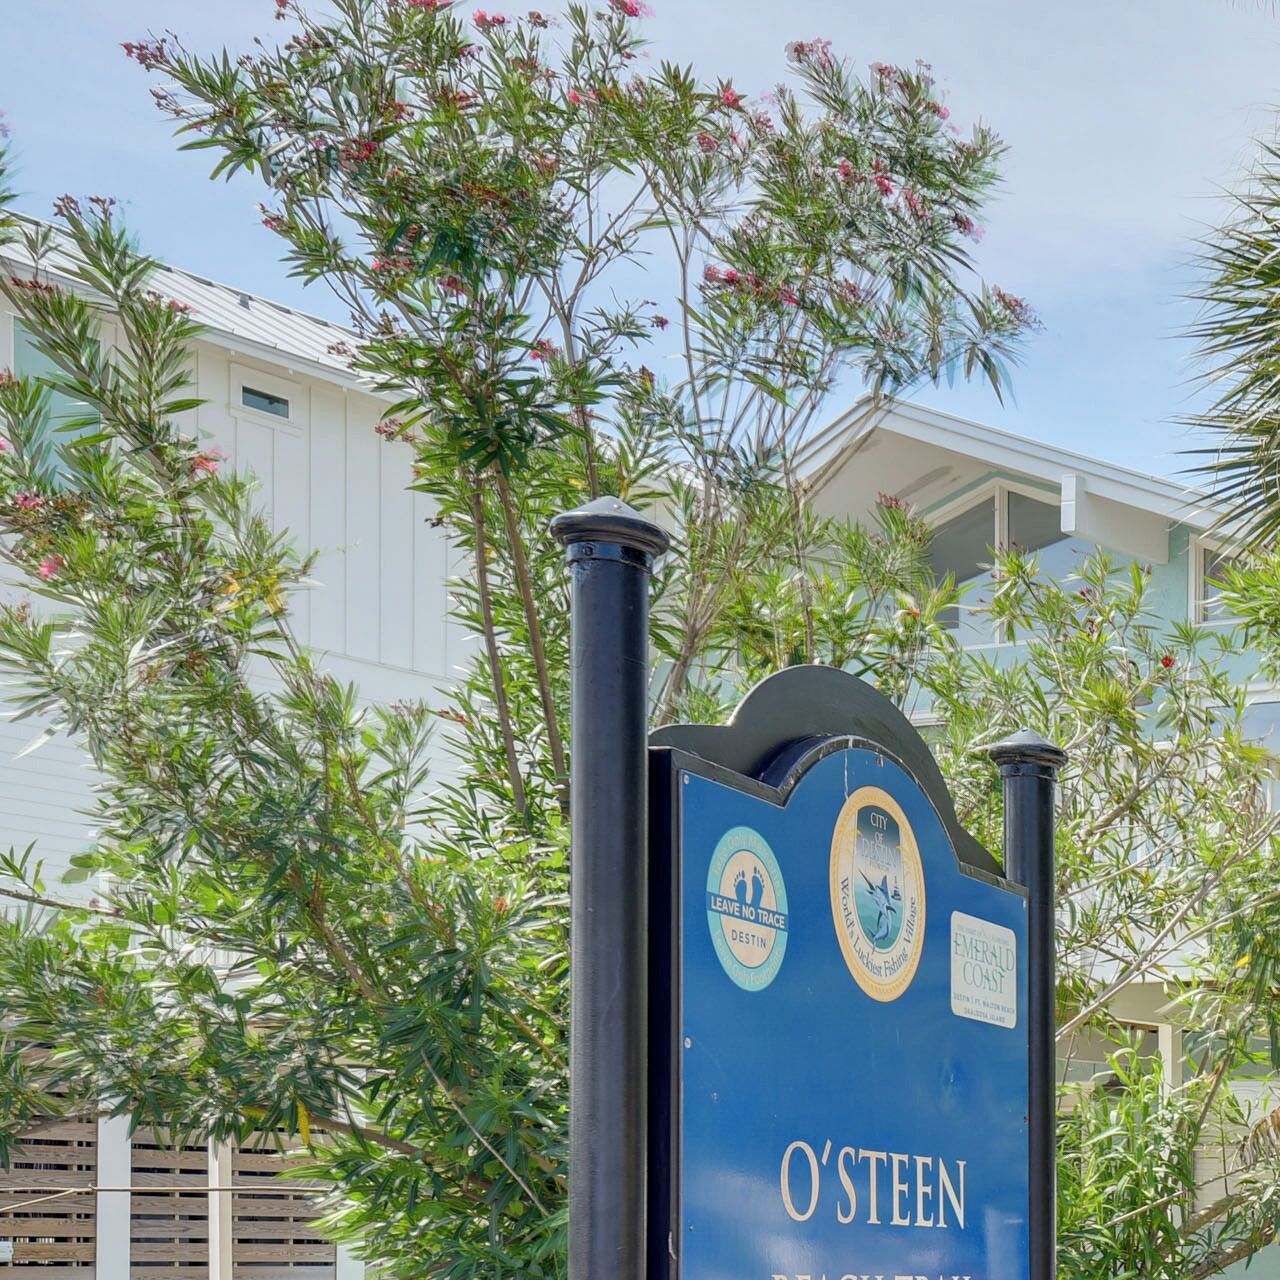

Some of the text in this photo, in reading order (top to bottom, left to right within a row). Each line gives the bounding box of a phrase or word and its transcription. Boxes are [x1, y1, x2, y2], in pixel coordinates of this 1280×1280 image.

[870, 812, 888, 830] CITY
[875, 832, 883, 845] OF
[711, 895, 785, 928] LEAVE NO TRACE
[840, 876, 855, 939] World's
[853, 935, 882, 977] Luckiest
[884, 948, 908, 977] Fishing
[904, 896, 918, 943] Village
[731, 929, 767, 948] DESTIN
[953, 932, 1015, 972] EMERALD
[963, 961, 1005, 994] COAST
[780, 1137, 967, 1230] O'STEEN
